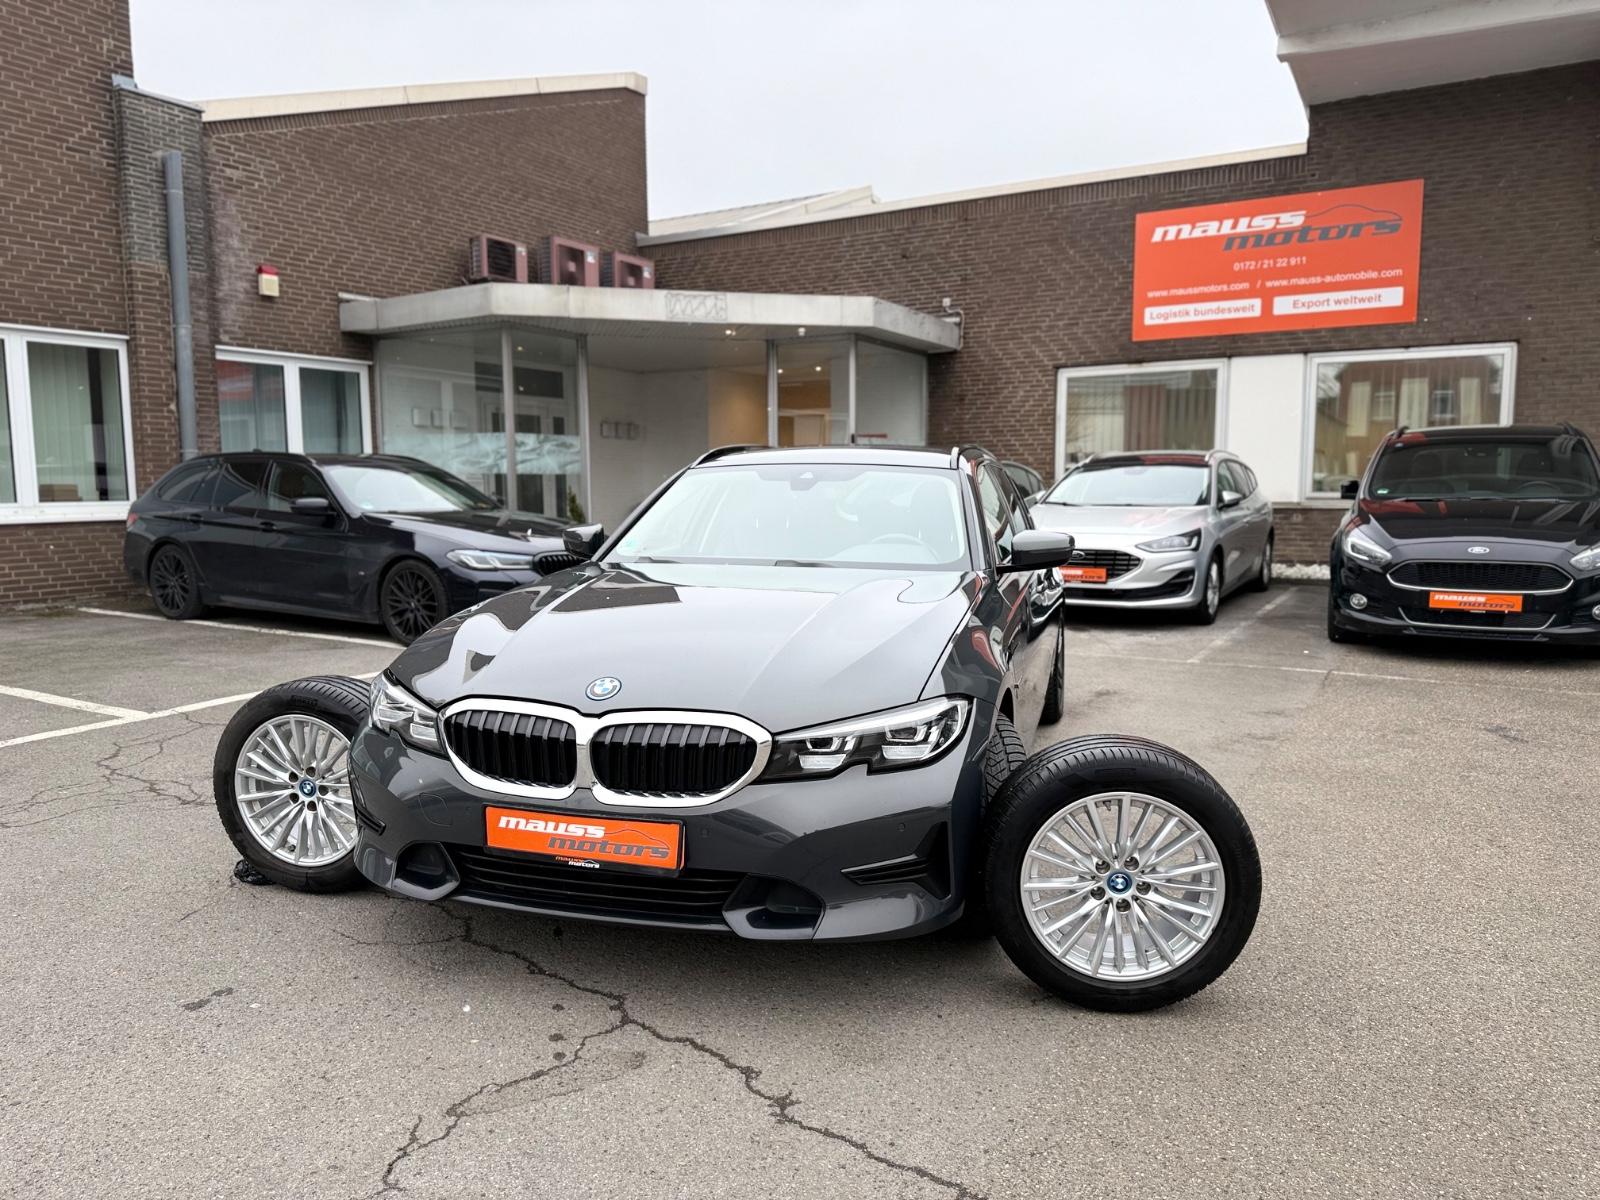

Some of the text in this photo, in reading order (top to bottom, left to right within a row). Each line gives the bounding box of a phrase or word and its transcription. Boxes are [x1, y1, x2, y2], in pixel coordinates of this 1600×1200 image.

[1151, 210, 1307, 243] mauss
[1222, 218, 1403, 252] motors
[1233, 260, 1256, 271] 0172
[1263, 258, 1274, 269] 21
[1276, 257, 1288, 268] 22
[1289, 256, 1307, 267] 911
[1147, 281, 1249, 298] www.maussmotors.com
[1265, 268, 1403, 289] www.mauss-automobile.com
[1149, 304, 1255, 321] Logistik bundesweit
[1292, 294, 1382, 312] Export weltweit
[498, 816, 605, 838] mauss
[548, 837, 669, 859] motors
